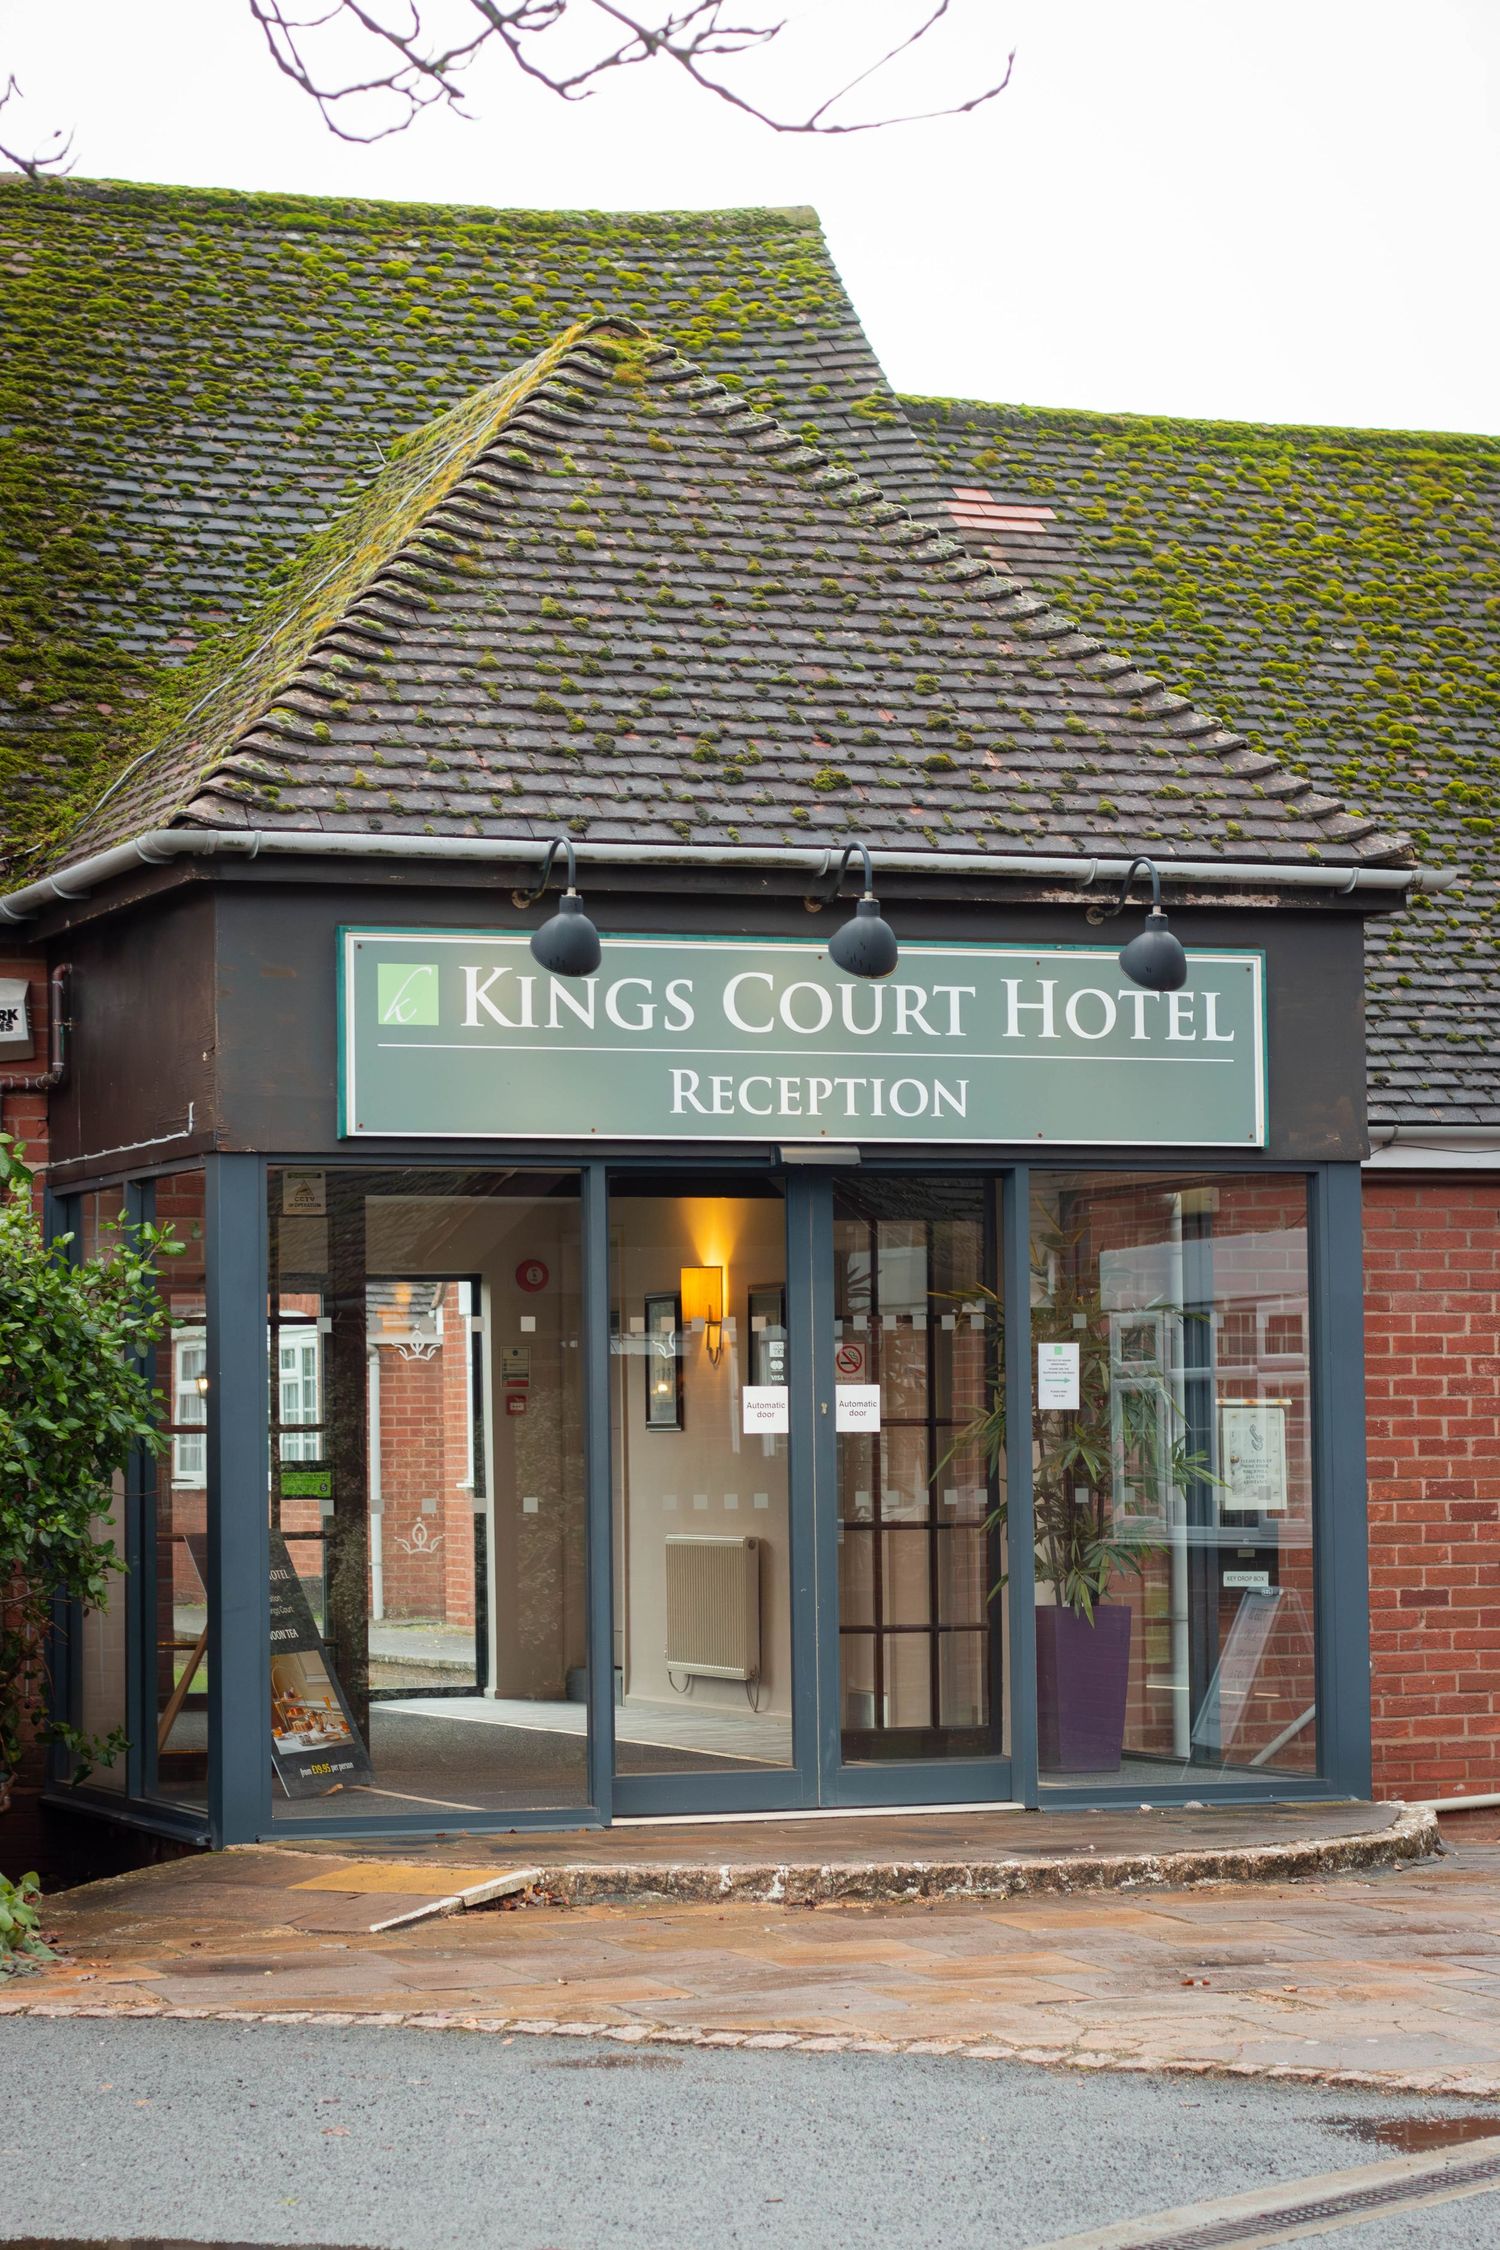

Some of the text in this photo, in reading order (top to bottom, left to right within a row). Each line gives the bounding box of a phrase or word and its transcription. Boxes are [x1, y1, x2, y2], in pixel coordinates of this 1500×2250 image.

[458, 965, 1236, 1044] KINGS COURT HOTEL
[668, 1068, 970, 1119] RECEPTION
[746, 1401, 786, 1409] Automatic
[838, 1399, 877, 1408] Automatic
[848, 1408, 867, 1417] door
[269, 1569, 291, 1580] OTEL
[285, 1628, 299, 1639] TEA
